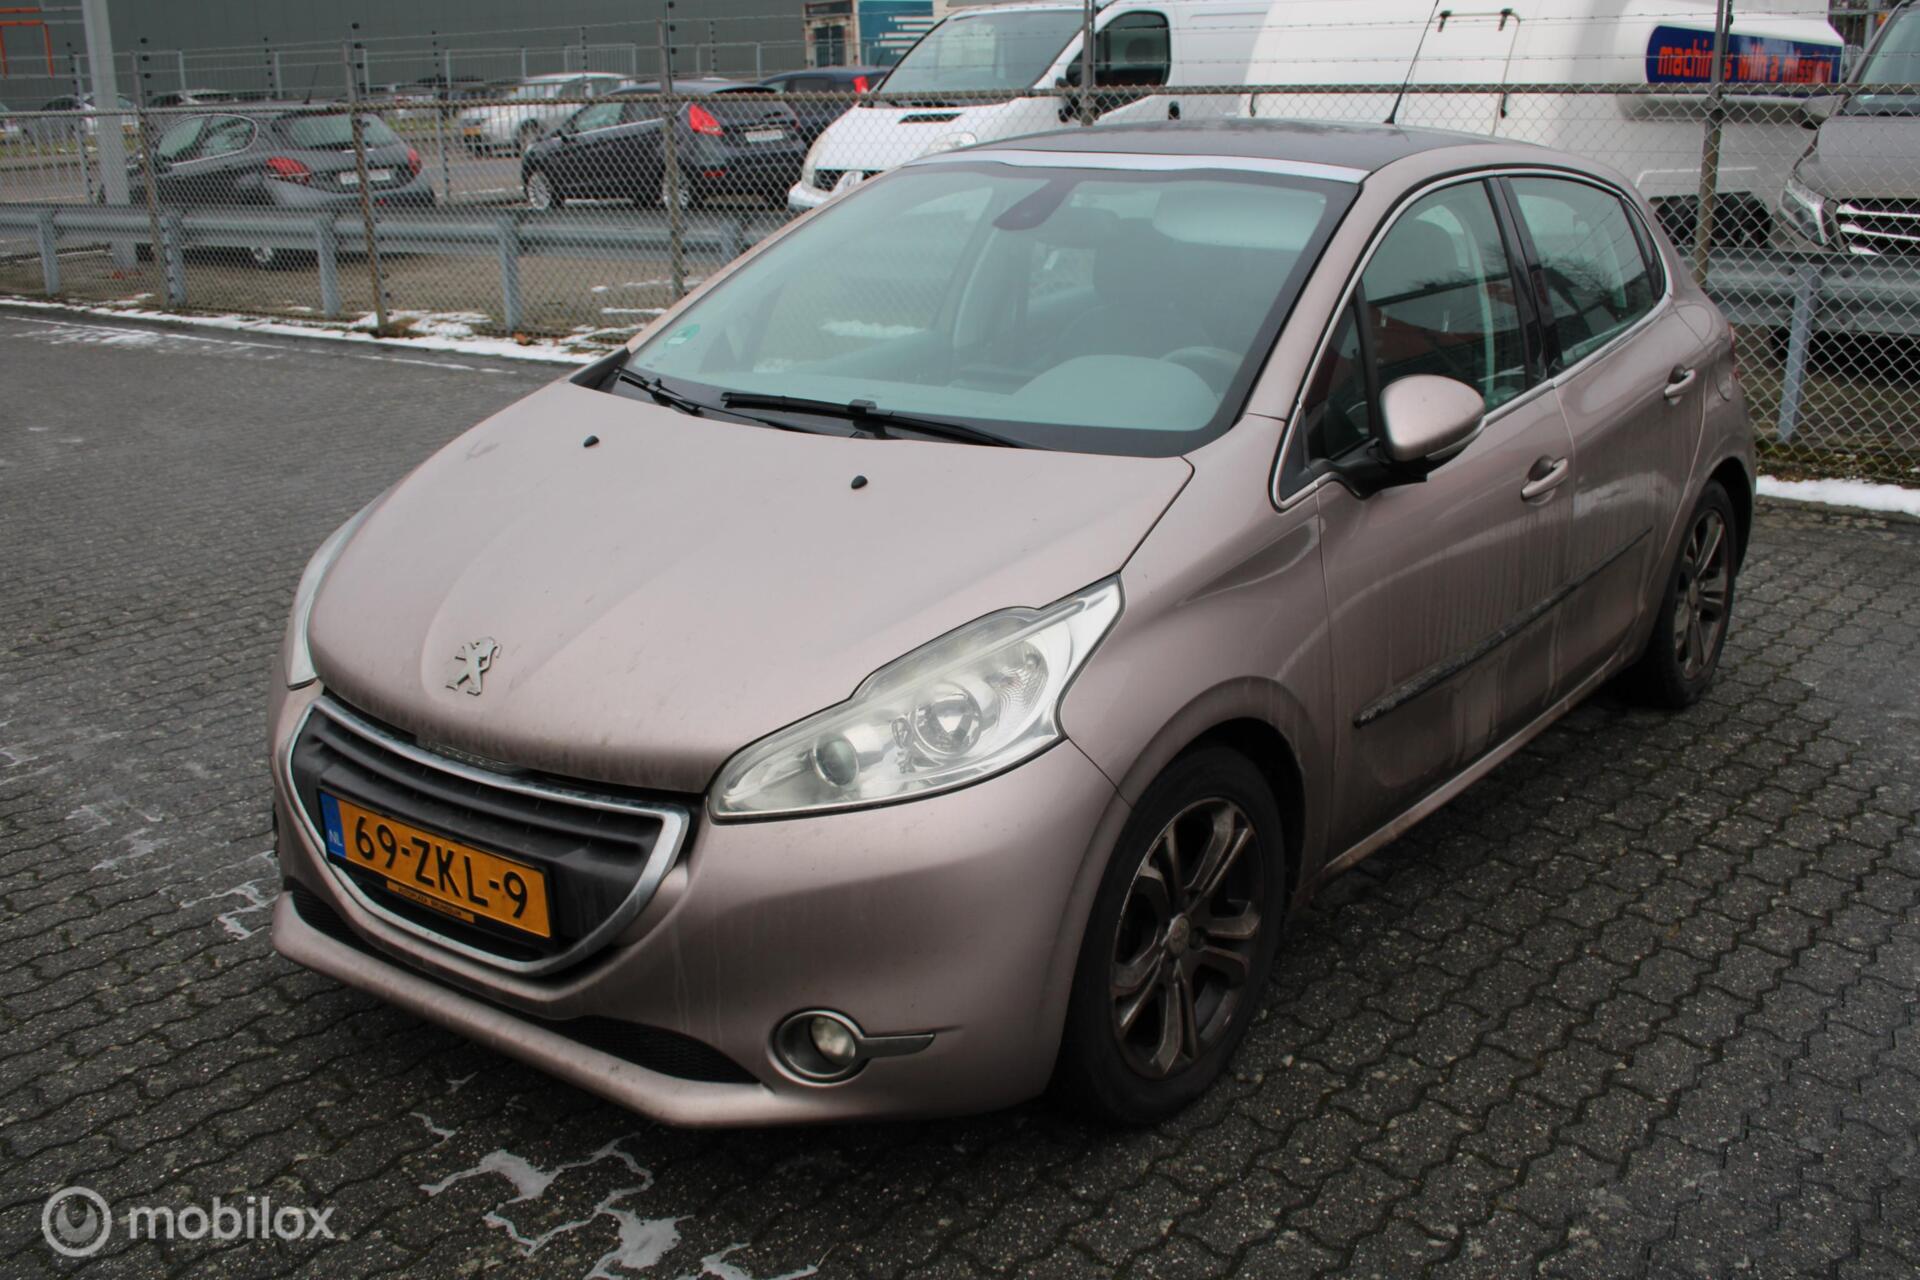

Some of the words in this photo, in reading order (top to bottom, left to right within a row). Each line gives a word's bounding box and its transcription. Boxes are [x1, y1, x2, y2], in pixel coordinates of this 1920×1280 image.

[1769, 54, 1780, 82] a
[328, 829, 343, 848] NL
[355, 815, 528, 920] 69-ZKL-9
